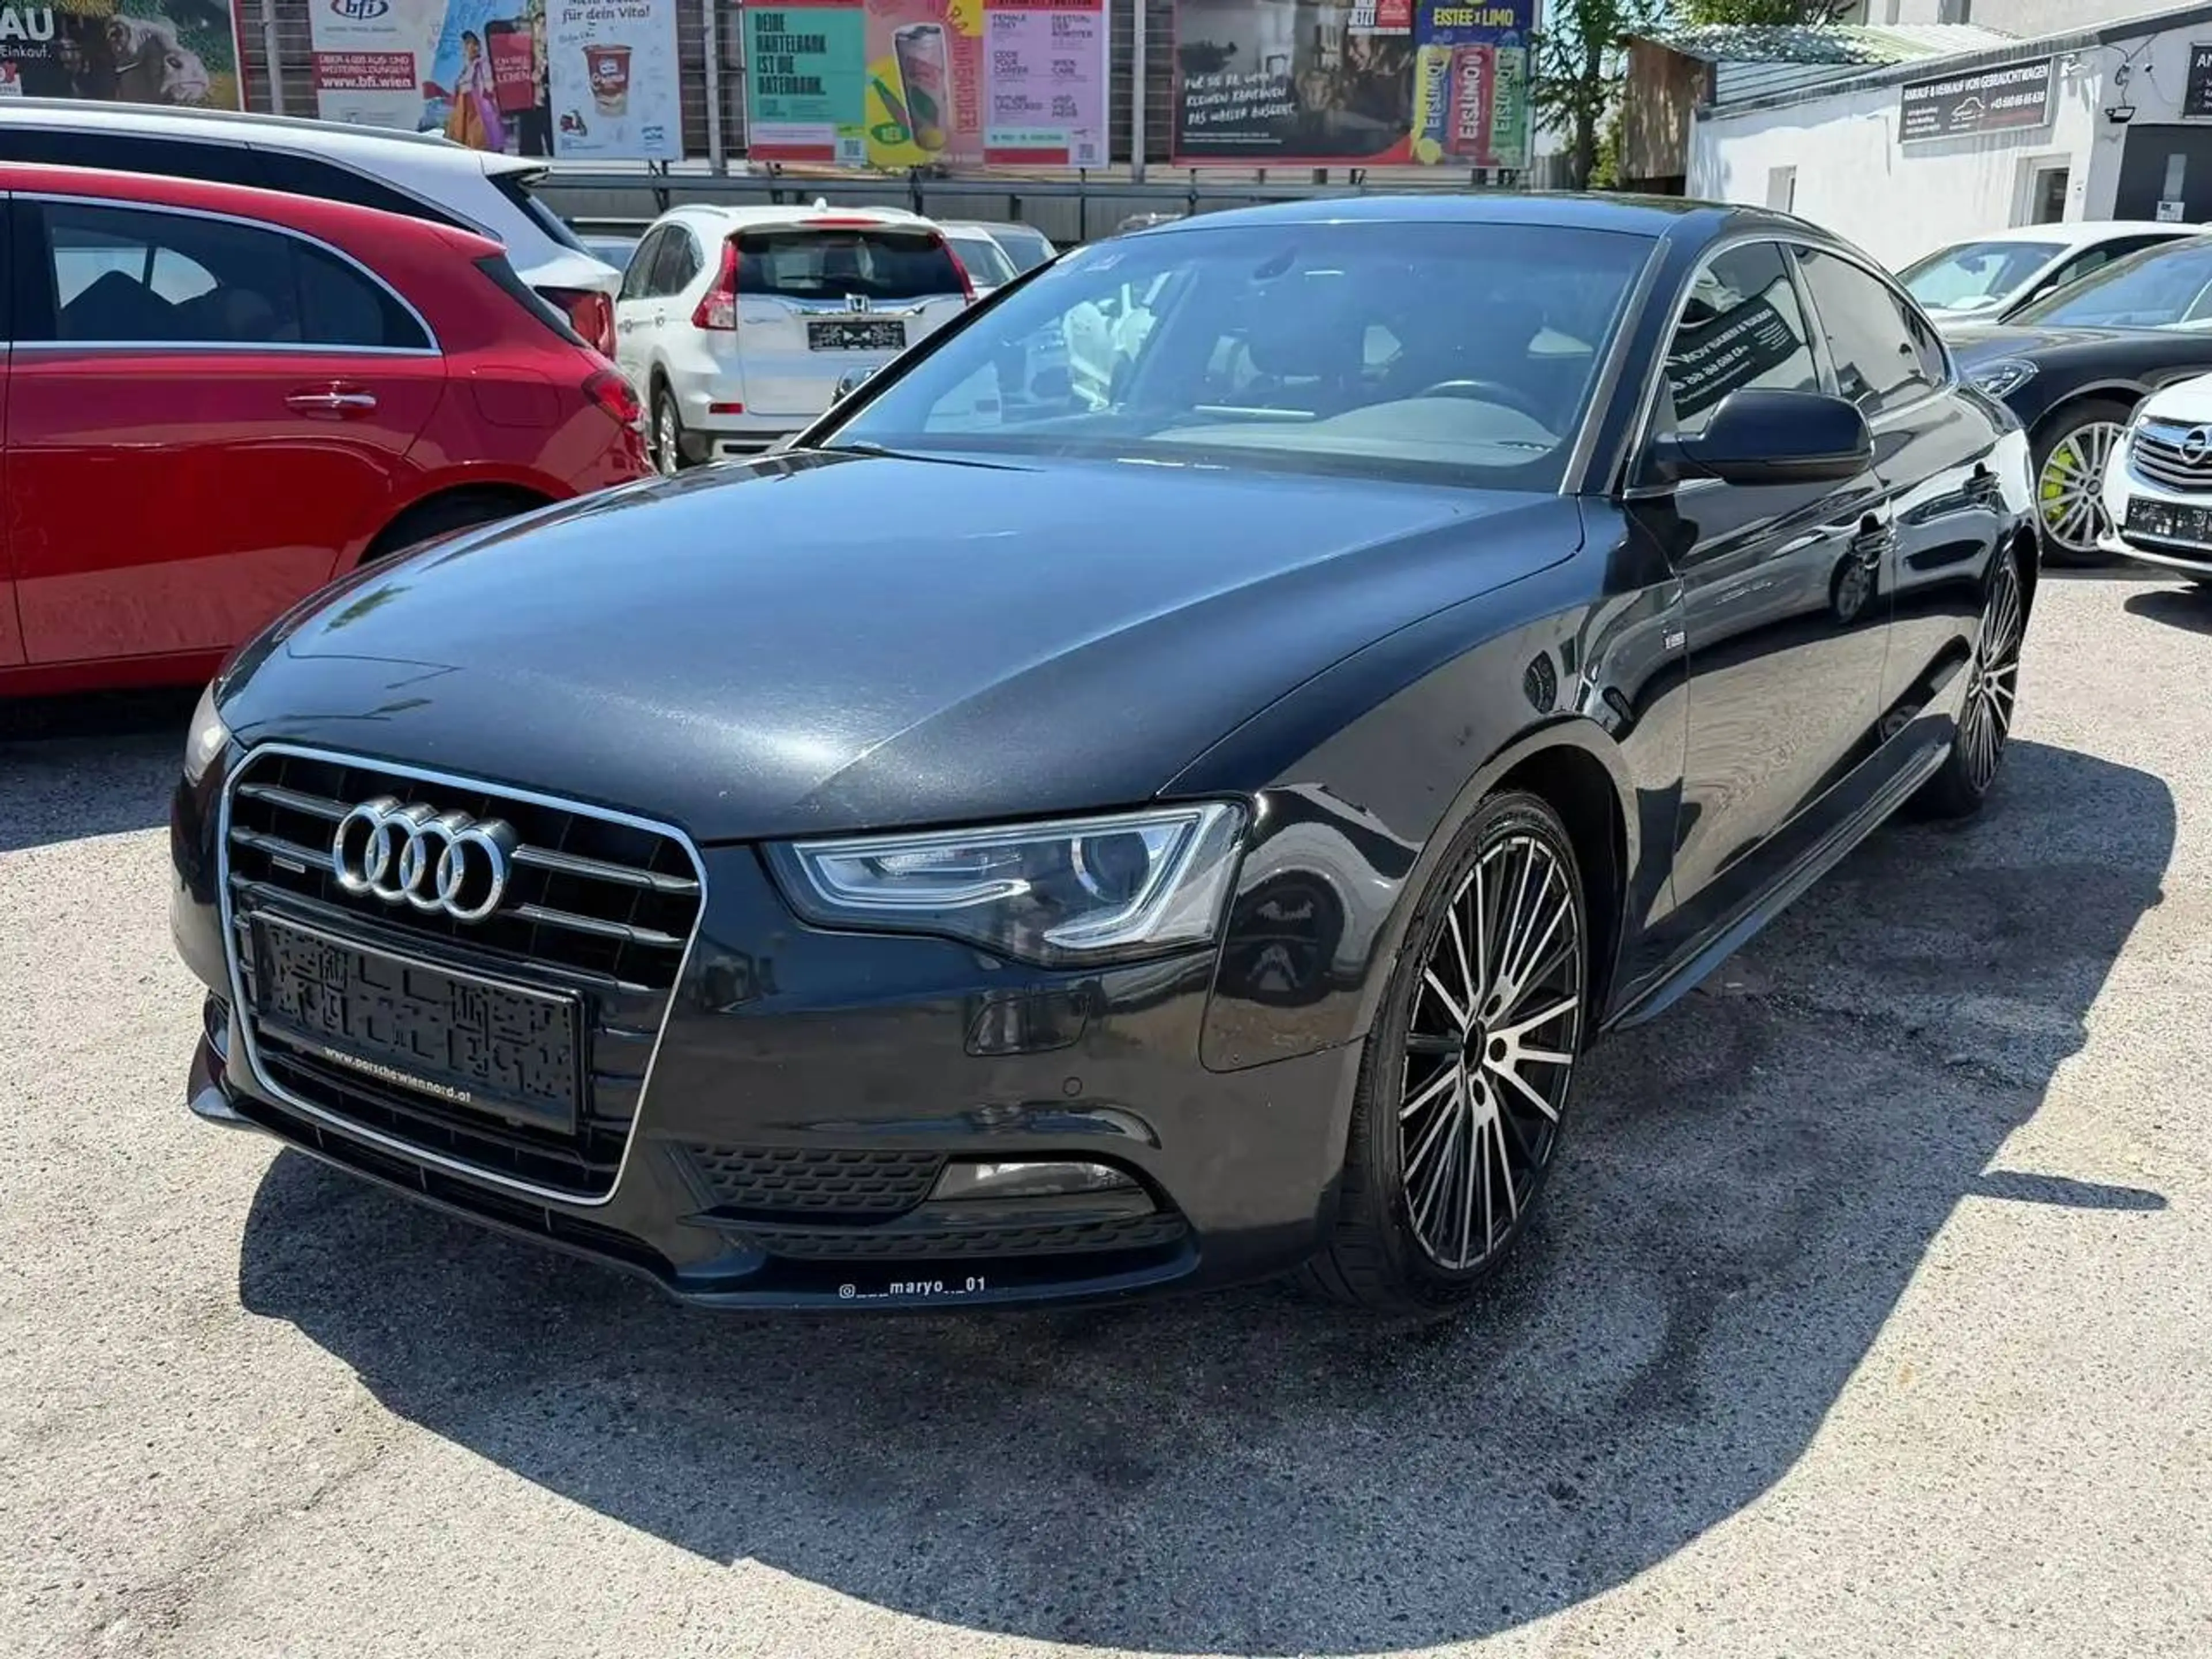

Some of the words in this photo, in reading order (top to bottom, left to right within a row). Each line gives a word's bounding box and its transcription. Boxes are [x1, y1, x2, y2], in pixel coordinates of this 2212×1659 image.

[562, 8, 584, 24] für
[586, 6, 615, 20] dein
[1434, 7, 1474, 27] EISTEE
[1482, 7, 1514, 27] LIMO
[756, 55, 774, 74] IST
[321, 75, 412, 88] www.bfi.wien
[324, 1046, 472, 1103] www.porschewiennord.at
